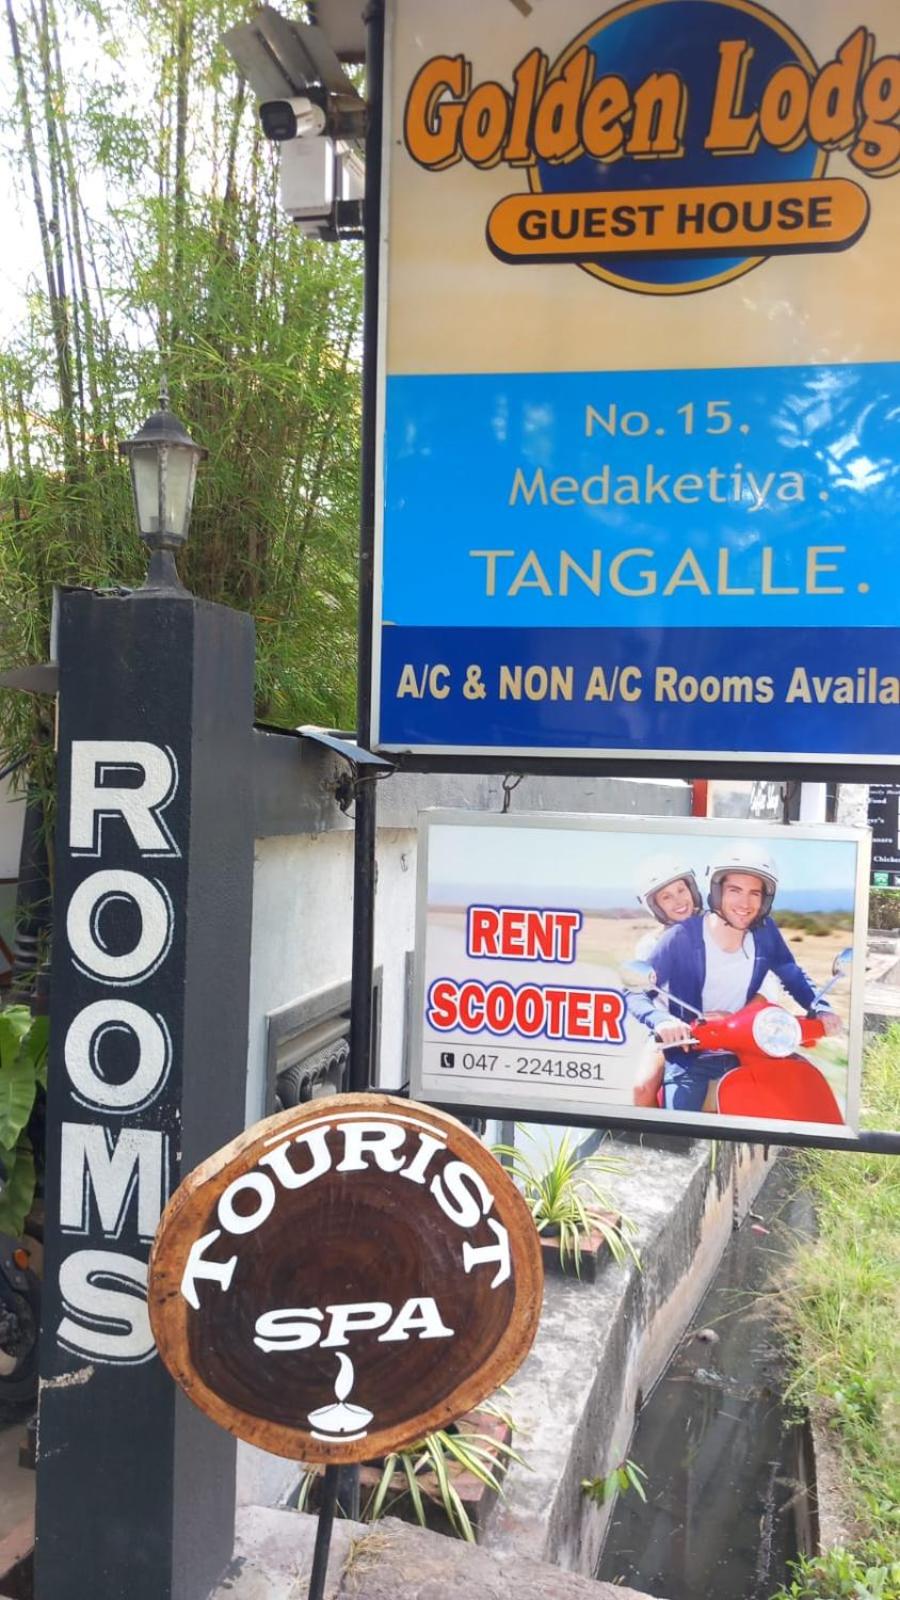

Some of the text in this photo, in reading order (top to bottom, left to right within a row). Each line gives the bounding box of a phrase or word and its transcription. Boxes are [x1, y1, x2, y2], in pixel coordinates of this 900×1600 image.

[403, 45, 688, 171] Golden
[517, 196, 833, 241] GUEST HOUSE
[396, 664, 450, 700] A/C
[462, 665, 487, 700] &
[499, 666, 574, 701] NON
[585, 667, 643, 702] A/C
[654, 667, 774, 703] Rooms
[467, 904, 582, 963] RENT
[425, 978, 626, 1044] SCOOTER
[57, 740, 182, 1365] ROOMS
[462, 1053, 499, 1072] 047
[516, 1057, 604, 1081] 2241881
[181, 1122, 511, 1309] TOURIST
[253, 1297, 455, 1353] SPA
